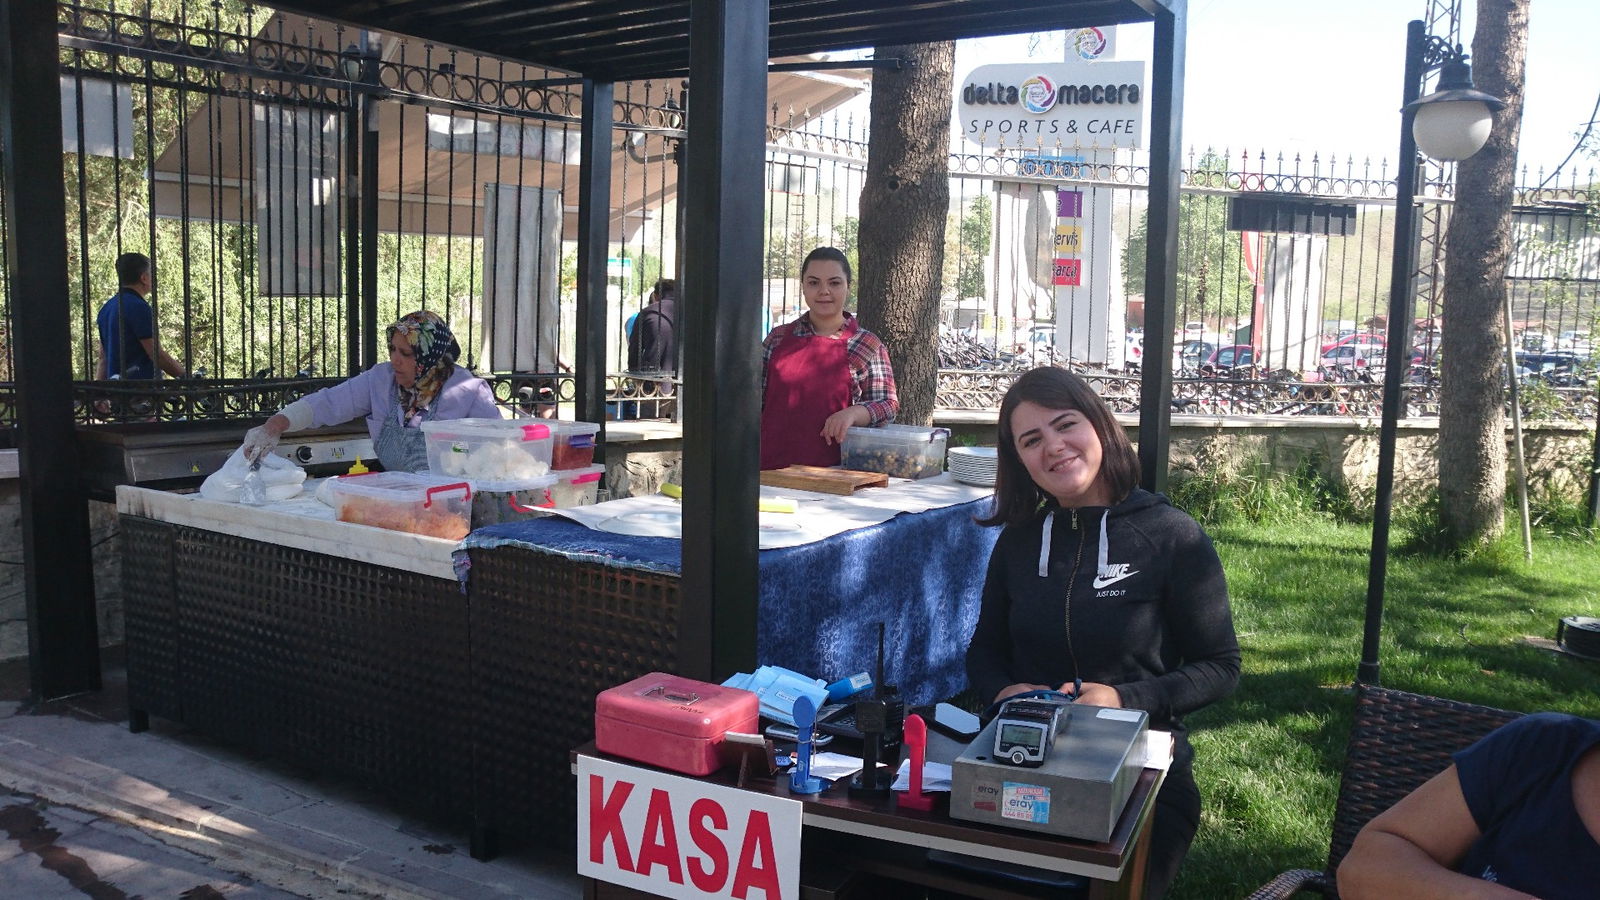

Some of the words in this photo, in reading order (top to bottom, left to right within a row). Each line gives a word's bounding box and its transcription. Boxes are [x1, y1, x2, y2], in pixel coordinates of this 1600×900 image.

[963, 82, 1019, 105] delta
[1058, 82, 1140, 105] macera
[969, 118, 1059, 134] SPORTS
[1066, 118, 1078, 134] &
[1087, 118, 1135, 134] CAFE
[1054, 231, 1078, 246] ervis
[1096, 590, 1109, 598] JUST
[977, 784, 999, 796] eray
[1009, 798, 1034, 810] eray
[589, 773, 782, 900] KASA
